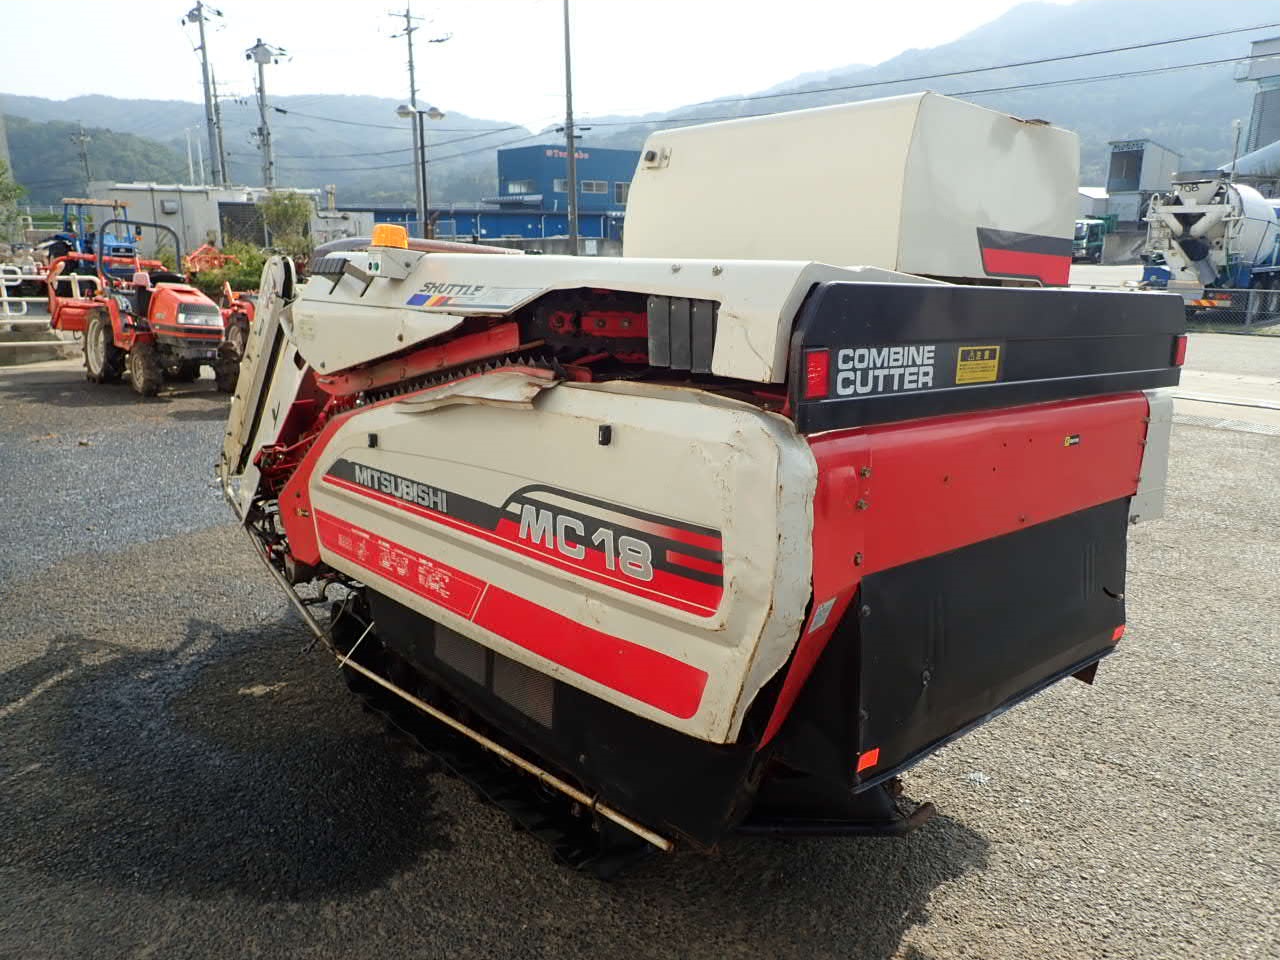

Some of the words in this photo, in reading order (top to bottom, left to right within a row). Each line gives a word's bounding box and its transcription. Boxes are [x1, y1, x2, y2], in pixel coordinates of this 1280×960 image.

[419, 282, 484, 296] SHUTTLE
[837, 345, 936, 370] COMBINE
[836, 365, 934, 396] CUTTER
[354, 464, 447, 514] MITSUBISHI
